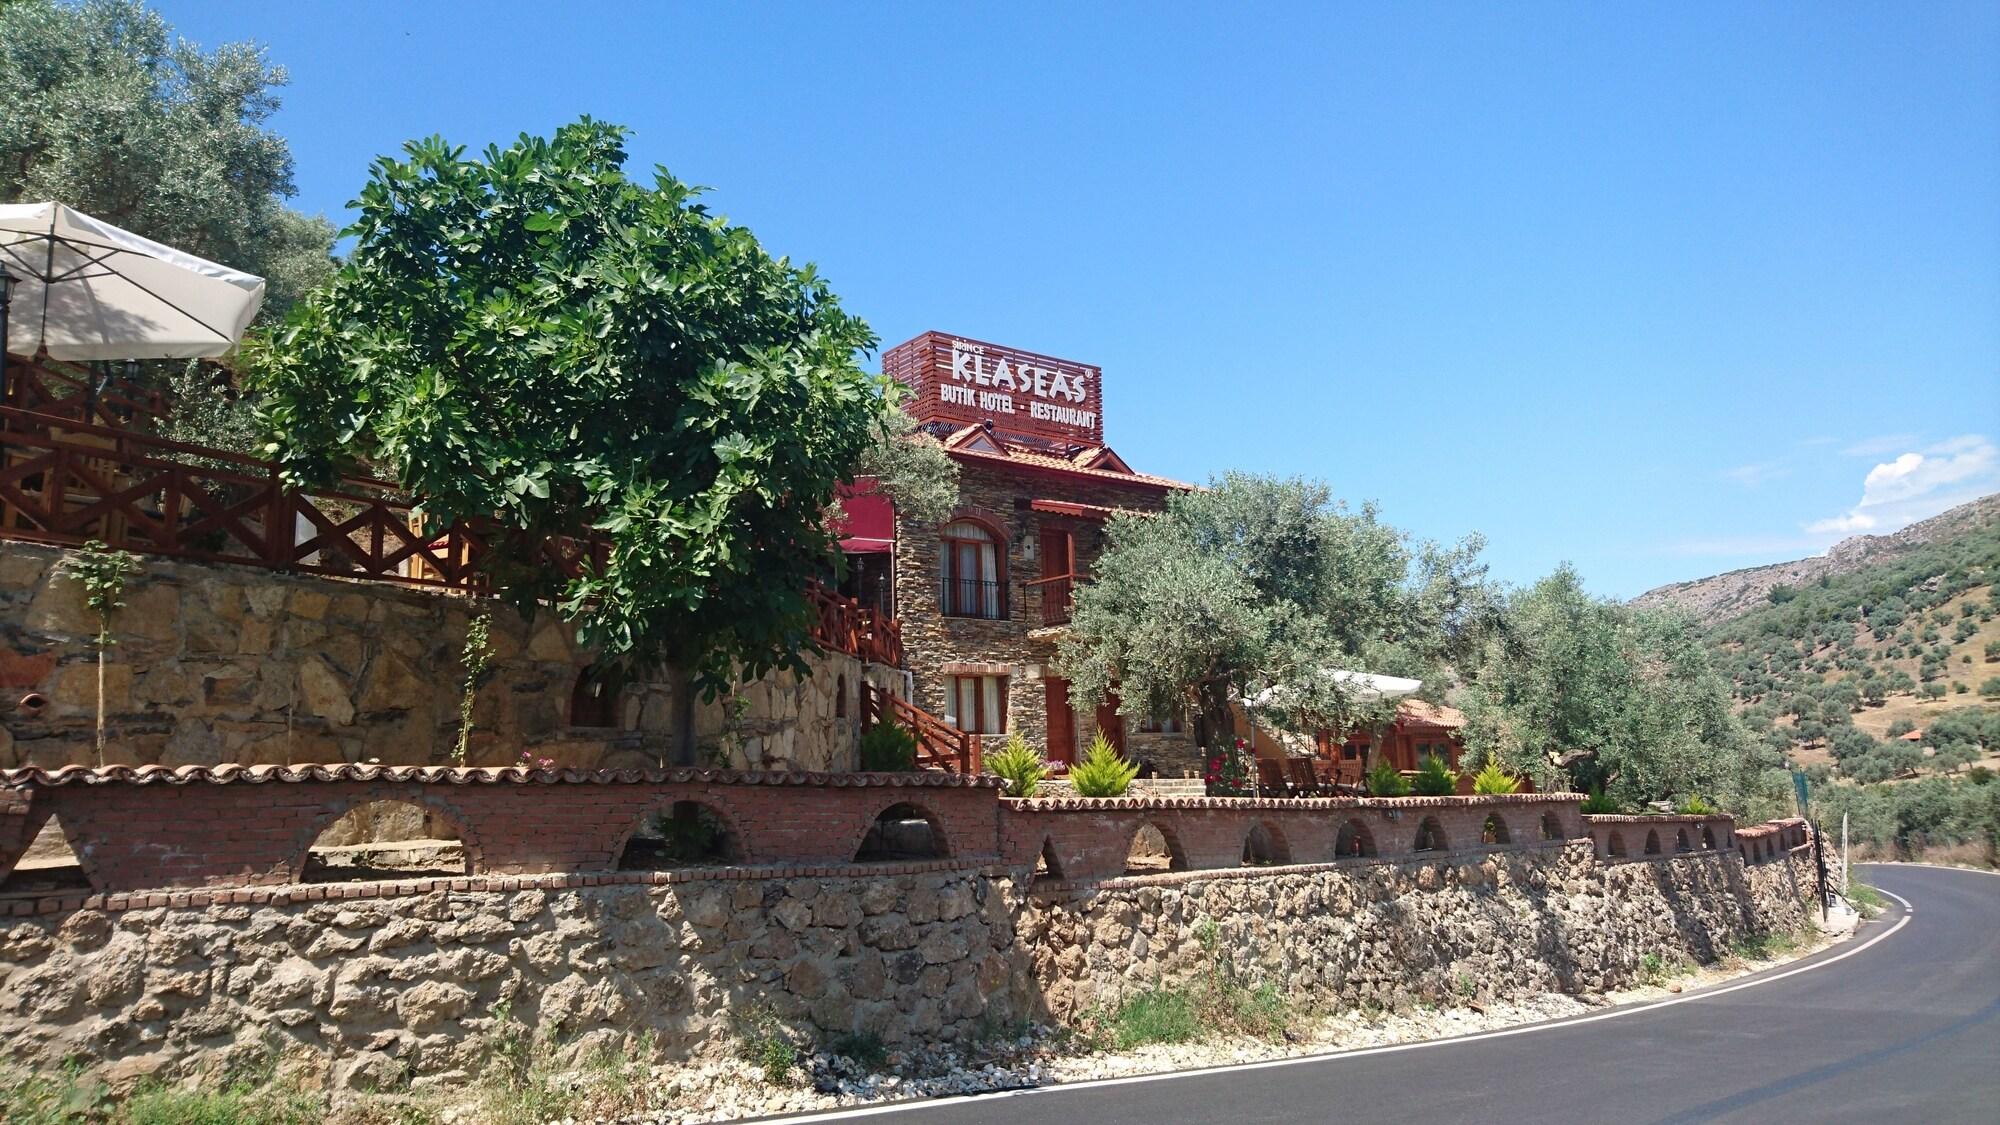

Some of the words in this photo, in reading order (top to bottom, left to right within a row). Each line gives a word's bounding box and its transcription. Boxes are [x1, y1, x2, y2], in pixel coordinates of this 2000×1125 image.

[952, 350, 1086, 403] KLASEAS
[979, 392, 1015, 414] HOTEL
[1030, 401, 1096, 429] RESTAURANT
